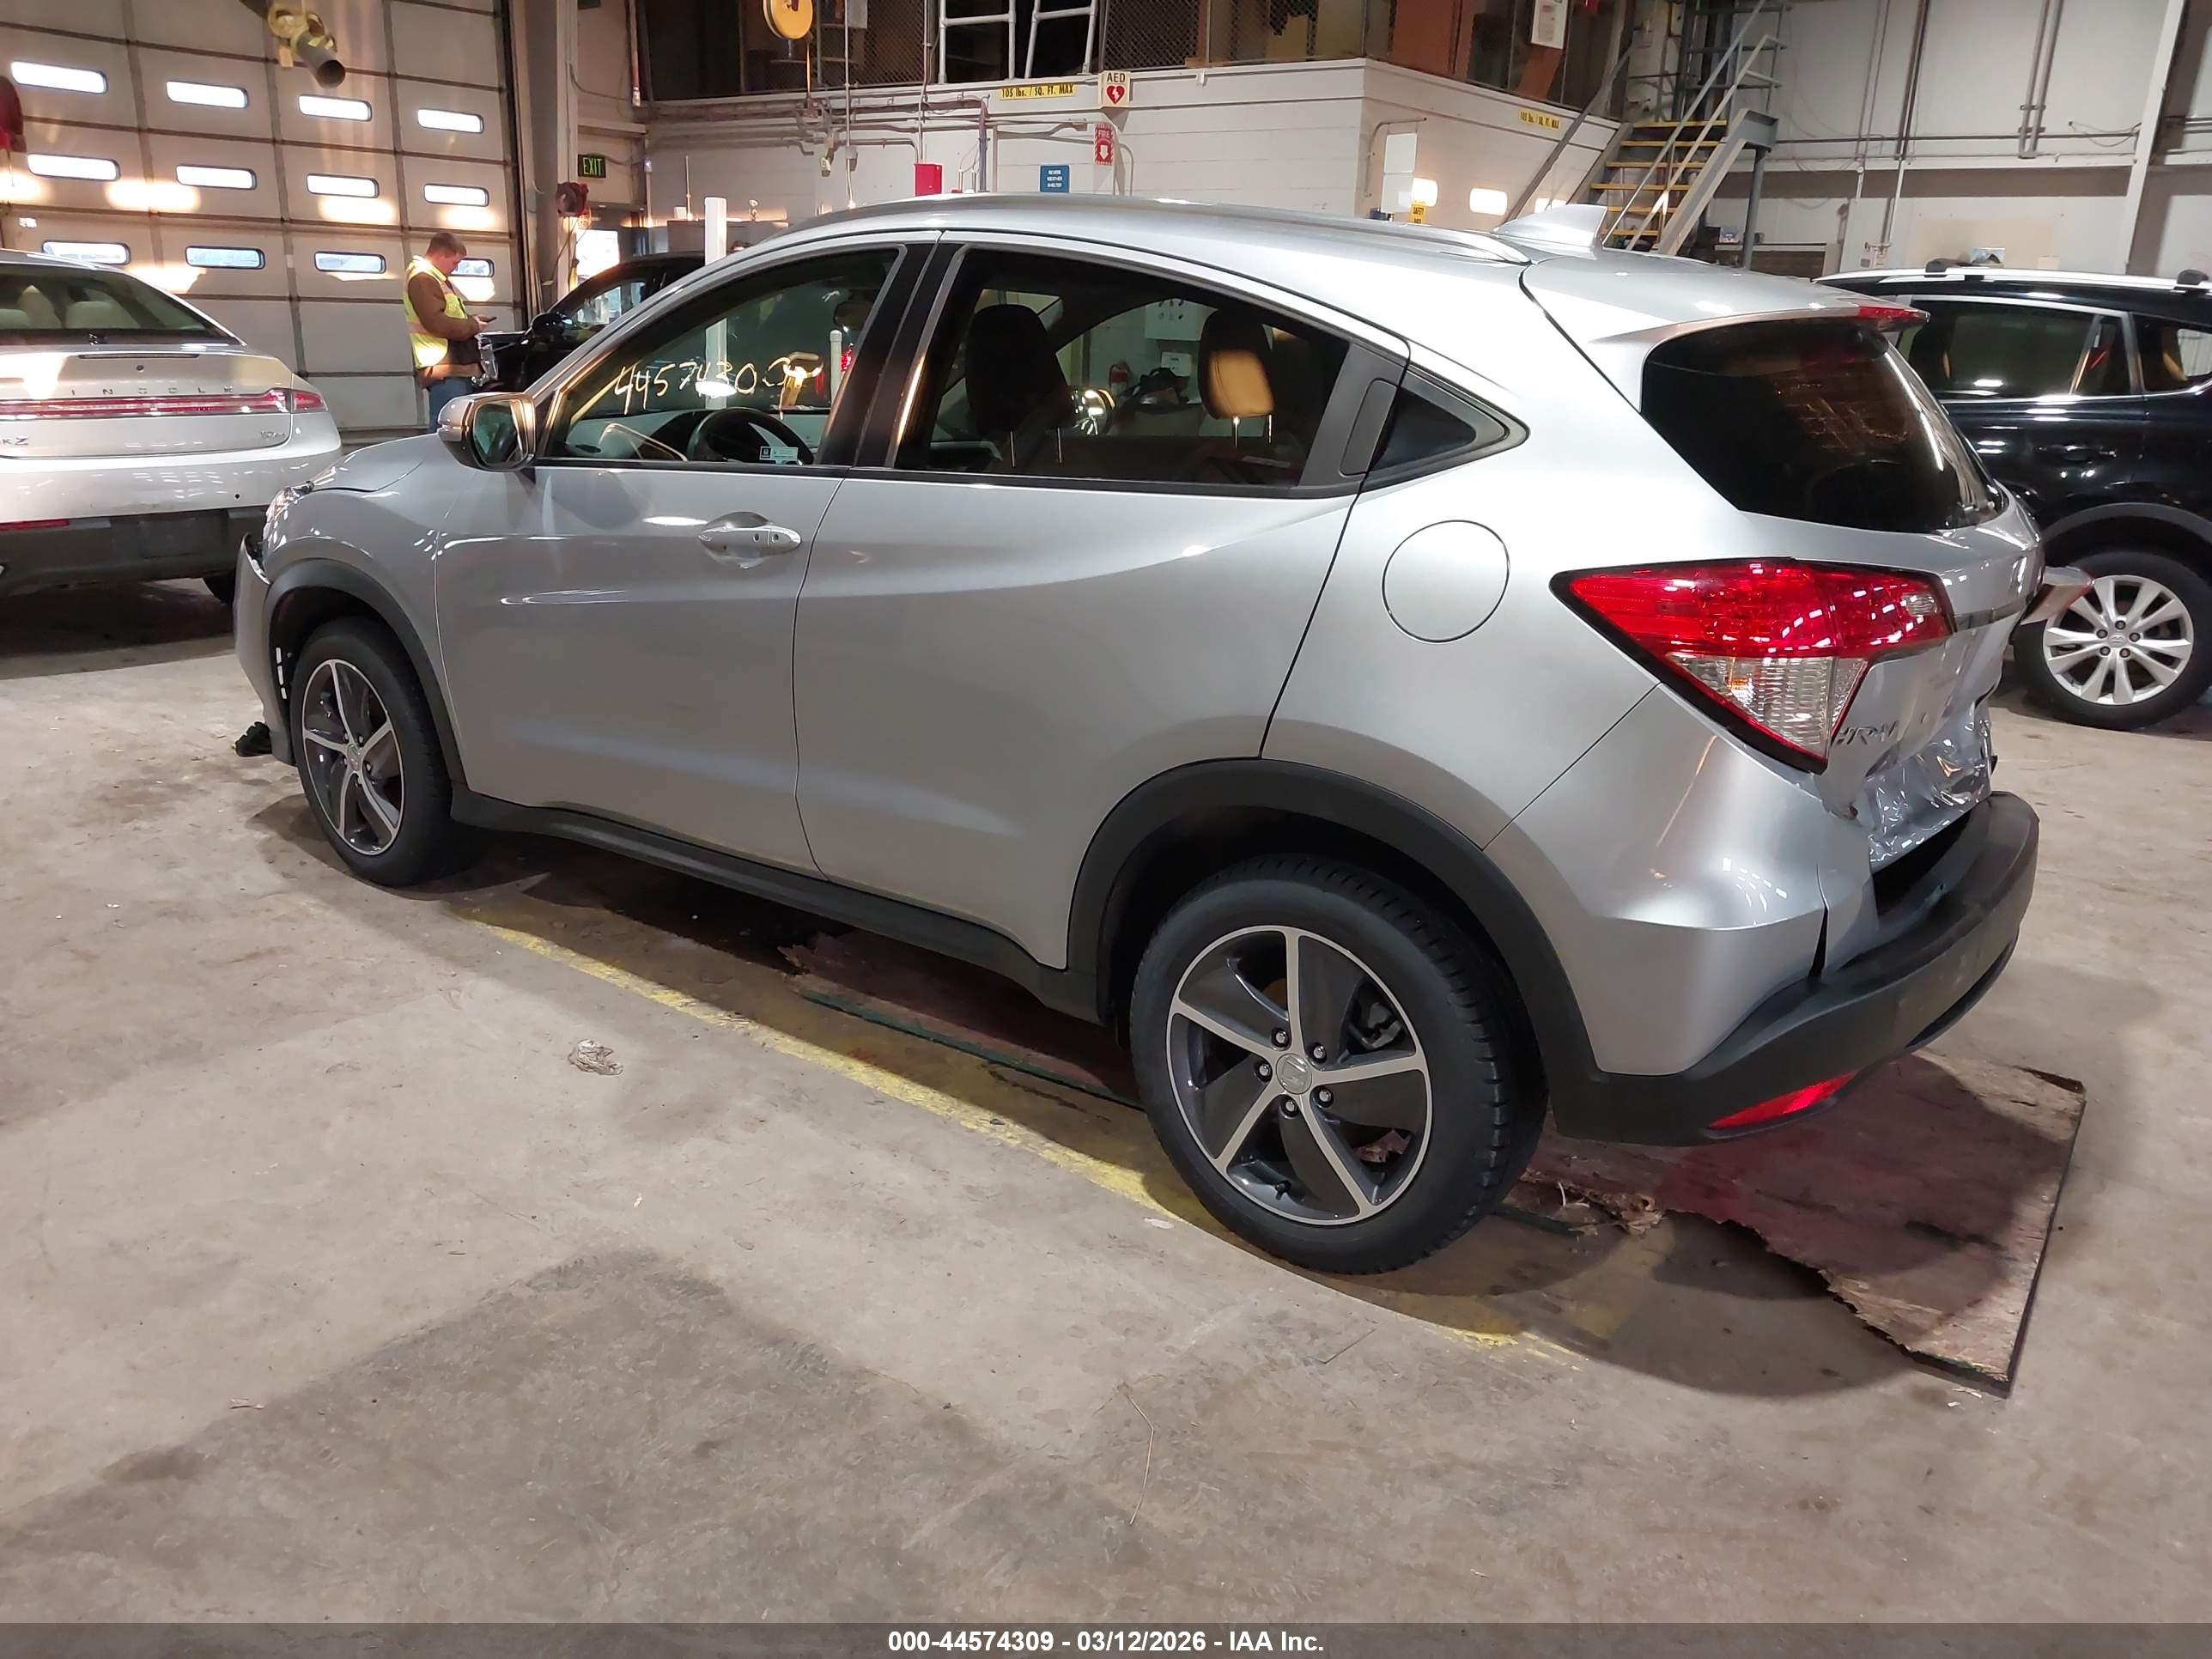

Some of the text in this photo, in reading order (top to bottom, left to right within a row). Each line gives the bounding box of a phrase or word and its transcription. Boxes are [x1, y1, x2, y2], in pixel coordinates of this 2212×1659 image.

[1106, 72, 1126, 83] AED
[1002, 88, 1013, 98] 105
[1015, 87, 1027, 97] lbs.
[1034, 86, 1045, 96] SQ.
[1047, 85, 1056, 94] FT.
[1059, 84, 1073, 94] MAX
[583, 157, 603, 176] EXIT
[0, 436, 28, 446] KZ
